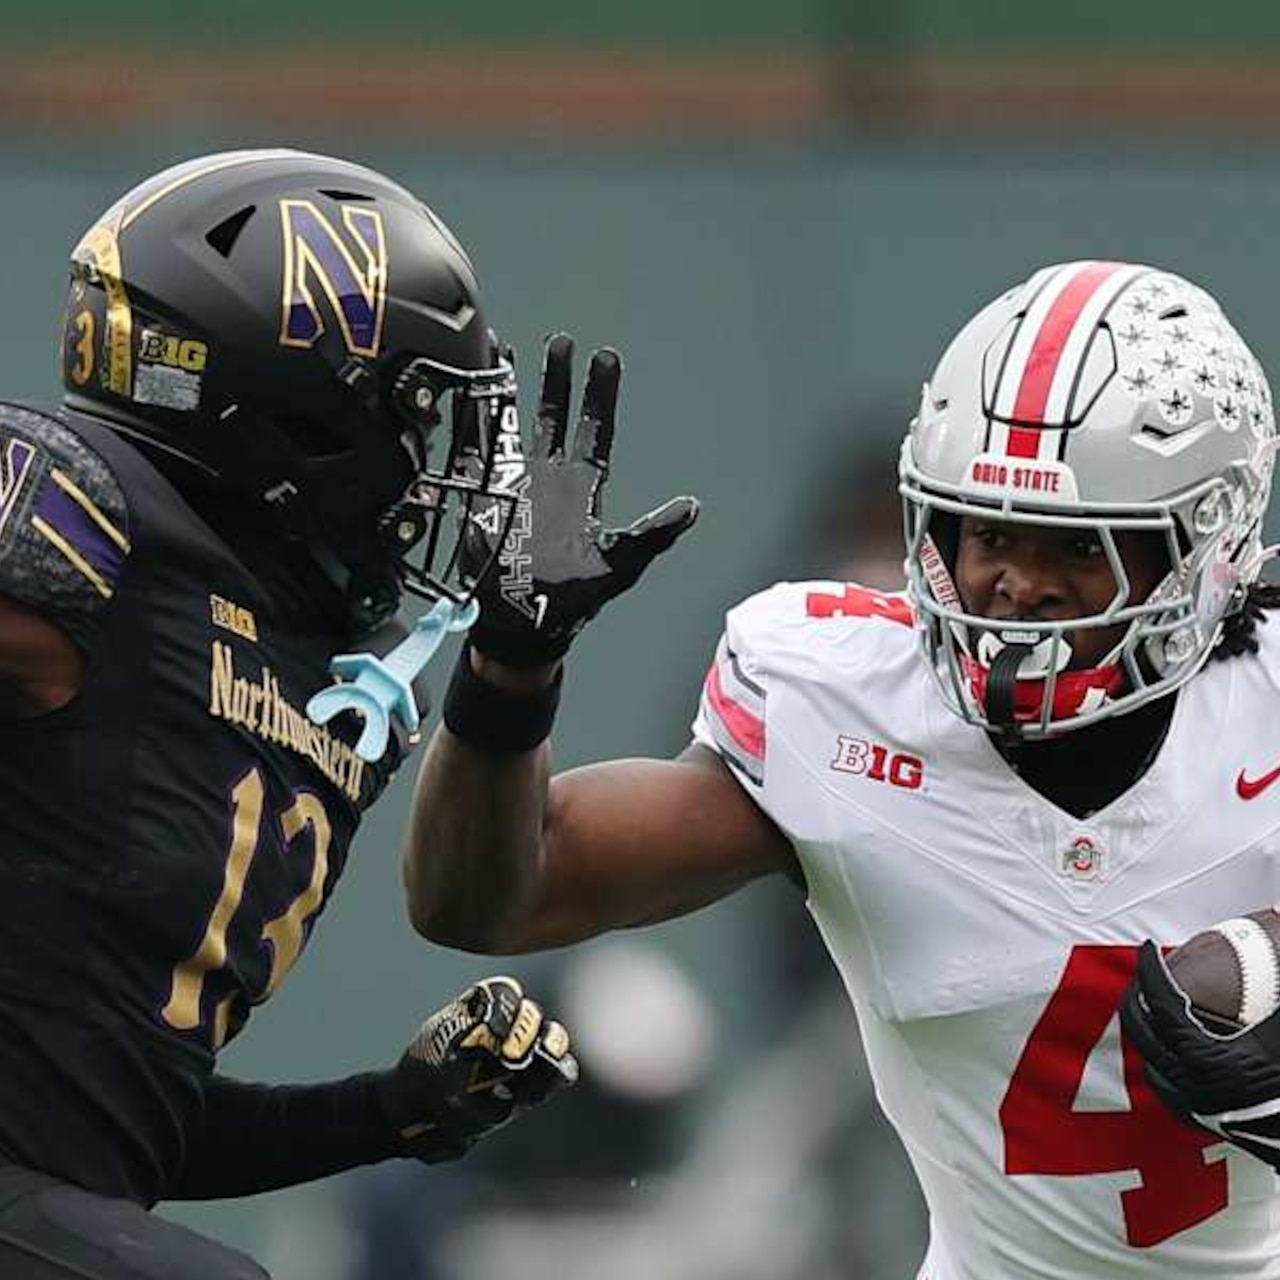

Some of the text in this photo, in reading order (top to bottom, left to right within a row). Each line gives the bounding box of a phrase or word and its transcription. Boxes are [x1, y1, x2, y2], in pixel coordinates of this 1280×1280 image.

[280, 200, 392, 359] N
[972, 462, 1061, 493] OHIO STATE
[209, 640, 366, 802] Northwestern
[160, 766, 333, 1050] 13
[999, 944, 1229, 1249] 4
